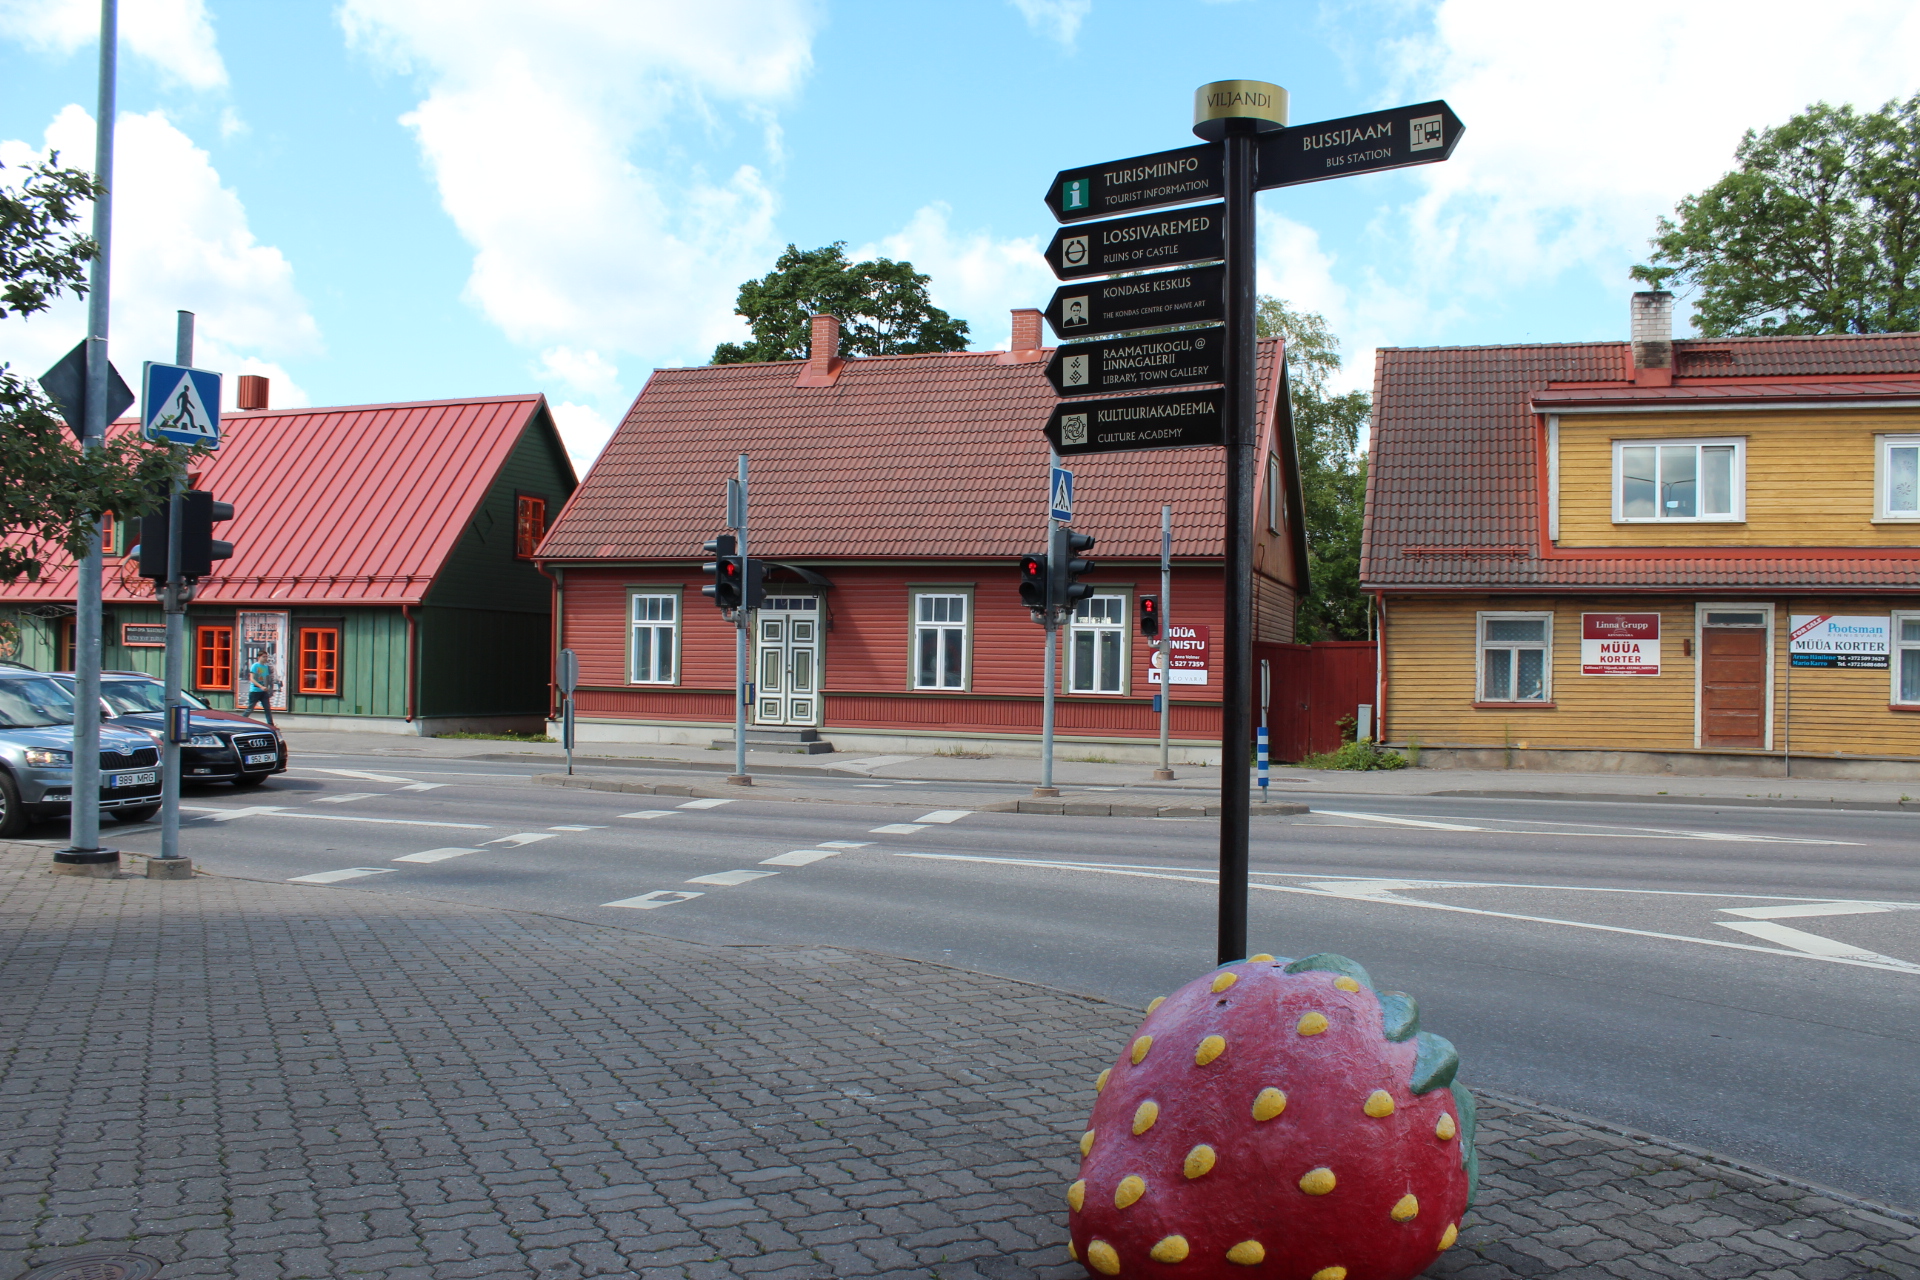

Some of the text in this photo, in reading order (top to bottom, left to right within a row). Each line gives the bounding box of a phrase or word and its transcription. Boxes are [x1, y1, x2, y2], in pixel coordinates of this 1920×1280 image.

[1207, 92, 1271, 108] VILJANDI
[1303, 121, 1392, 151] BUSSIJAAM
[1326, 147, 1392, 168] BUS STATION
[1104, 157, 1199, 187] TURISMIINFO
[1105, 179, 1209, 205] TOURIST INFORMATION
[1103, 217, 1210, 245] LOSSIVAREMED
[1103, 244, 1179, 264] RUINS OF CASTLE
[1103, 277, 1191, 298] KONDASE KESKUS
[1115, 309, 1140, 317] KONDAS
[1140, 305, 1163, 315] CENTRE
[1164, 304, 1173, 312] OF
[1194, 300, 1206, 308] ART
[1103, 338, 1206, 359] RAAMATUKOGU, @
[1103, 354, 1175, 371] LINNAGALERII
[1103, 366, 1209, 385] LIBRARY, TOWN GALLERY
[1098, 402, 1215, 422] KULTUURIAKADEEMIA
[1098, 429, 1183, 443] CULTURE ACADEMY
[1621, 621, 1648, 630] Grupp
[1793, 617, 1822, 638] FOR SALE
[1828, 623, 1883, 633] Pootsman
[246, 631, 279, 641] PIZZA
[1795, 639, 1885, 651] MÜÜA KORTER
[1601, 641, 1640, 653] MÜÜA
[118, 772, 154, 785] 989 MRG
